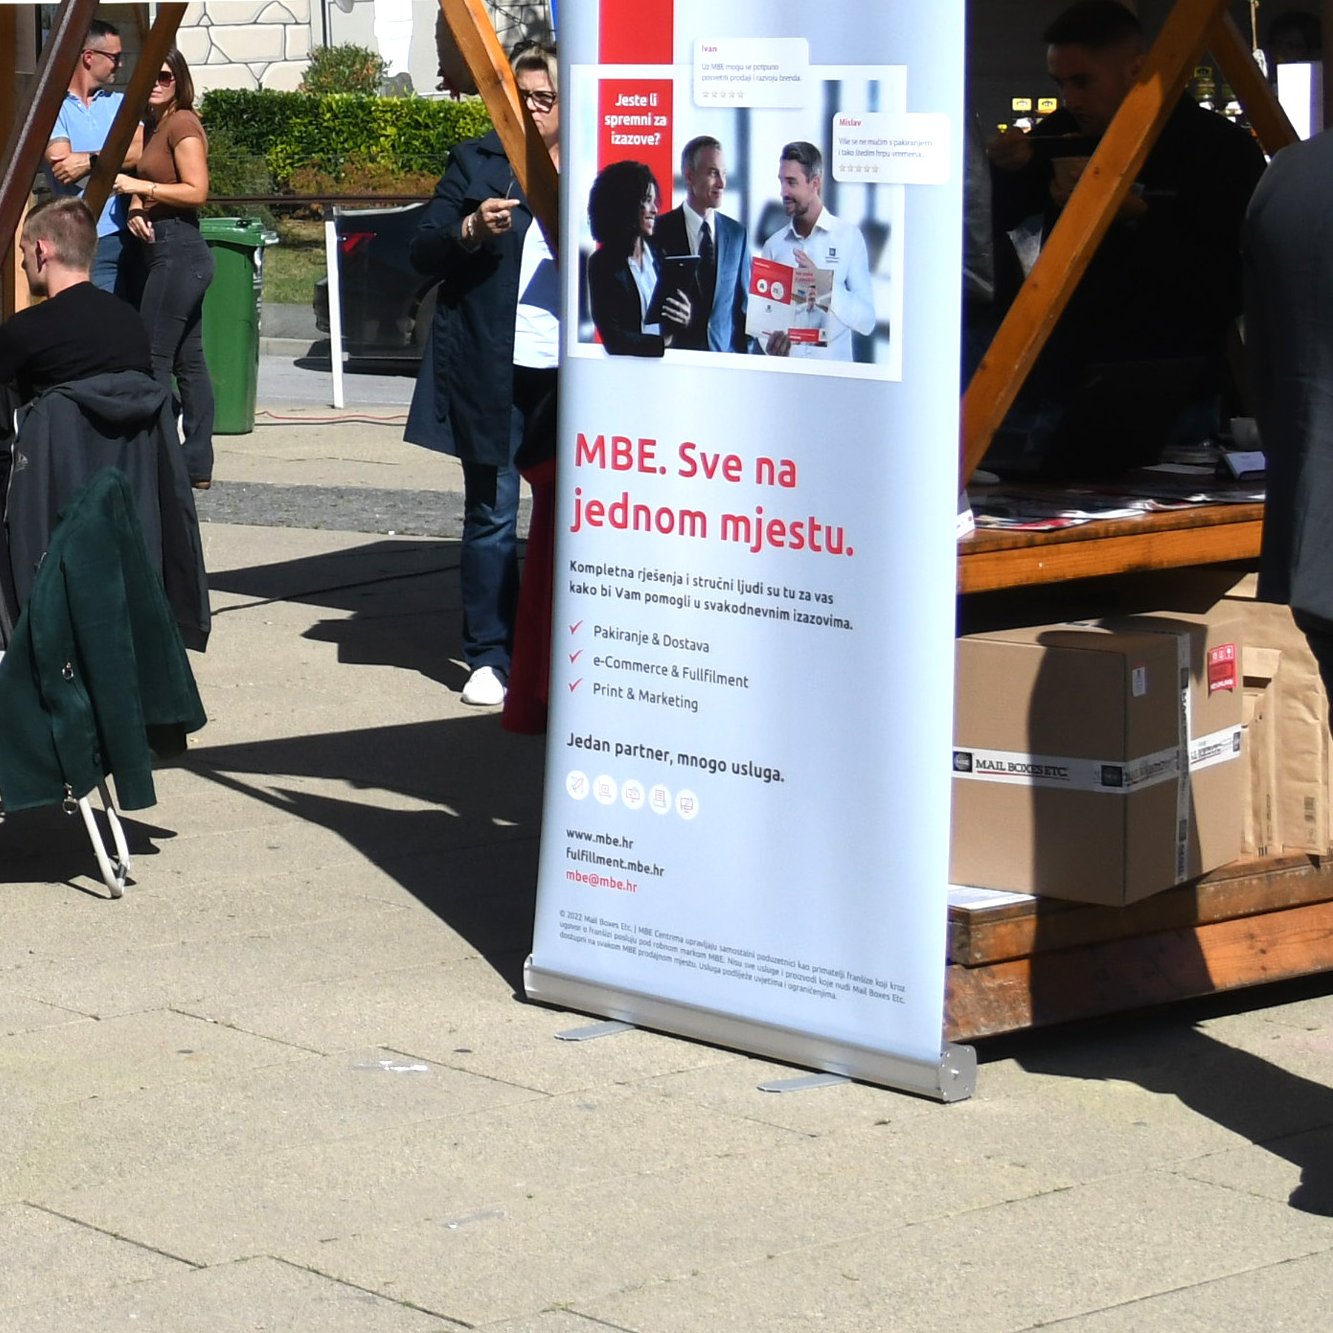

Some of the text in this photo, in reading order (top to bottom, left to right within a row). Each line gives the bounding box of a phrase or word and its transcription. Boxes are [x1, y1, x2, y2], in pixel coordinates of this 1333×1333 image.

[701, 44, 718, 53] Ivan
[726, 64, 744, 72] mogu
[753, 63, 779, 72] potpuno
[615, 93, 657, 107] Jeste li
[604, 113, 667, 129] spremni za
[838, 118, 862, 127] Mislav
[611, 131, 660, 146] izazove?
[574, 432, 797, 488] MBE. Sve na
[570, 488, 855, 557] jednom mjestu.
[569, 560, 834, 605] Kompletna rješenja i stručni ljudi su tu za vas
[569, 581, 854, 630] kako bi Vam pomogli u svakodnevnim izazovima.
[593, 625, 710, 653] Pakiranje & Dostava
[593, 654, 749, 688] e-Commerce & Fullfilment
[593, 682, 699, 713] Print & Marketing
[566, 732, 785, 783] Jedan partner, mnogo usluga.
[975, 758, 1006, 772] MAIL
[1008, 762, 1043, 775] BOXES
[566, 827, 634, 850] www.mbe.hr
[566, 846, 665, 878] fulfillment.mbe.hr
[565, 869, 638, 893] mbe@mbe.hr
[559, 930, 587, 944] dostupni
[597, 940, 621, 951] svakom
[622, 944, 637, 955] MBE
[638, 948, 673, 964] prodajnom
[698, 959, 721, 974] Usluga
[753, 974, 783, 988] uvjetima
[559, 921, 581, 932] ugovor
[614, 932, 638, 944] posluju
[639, 937, 652, 947] pod
[653, 941, 678, 953] robnom
[680, 947, 707, 959] markom
[708, 953, 725, 964] MBE.
[727, 957, 742, 968] Nisu
[744, 962, 755, 970] sve
[757, 965, 780, 977] usluge
[785, 971, 817, 985] proizvodi
[818, 976, 833, 989] koje
[835, 981, 851, 991] nudi
[852, 985, 867, 996] Mail
[869, 988, 891, 1001] Boxes
[892, 993, 906, 1004] Etc.
[567, 911, 583, 922] 2022
[584, 914, 598, 925] Mail
[599, 917, 619, 929] Boxes
[638, 925, 653, 937] MBE
[654, 929, 684, 943] Centrima
[719, 943, 755, 958] samostalni
[756, 952, 795, 968] poduzetnici
[797, 960, 810, 971] kao
[875, 977, 888, 989] koji
[889, 981, 906, 992] kroz
